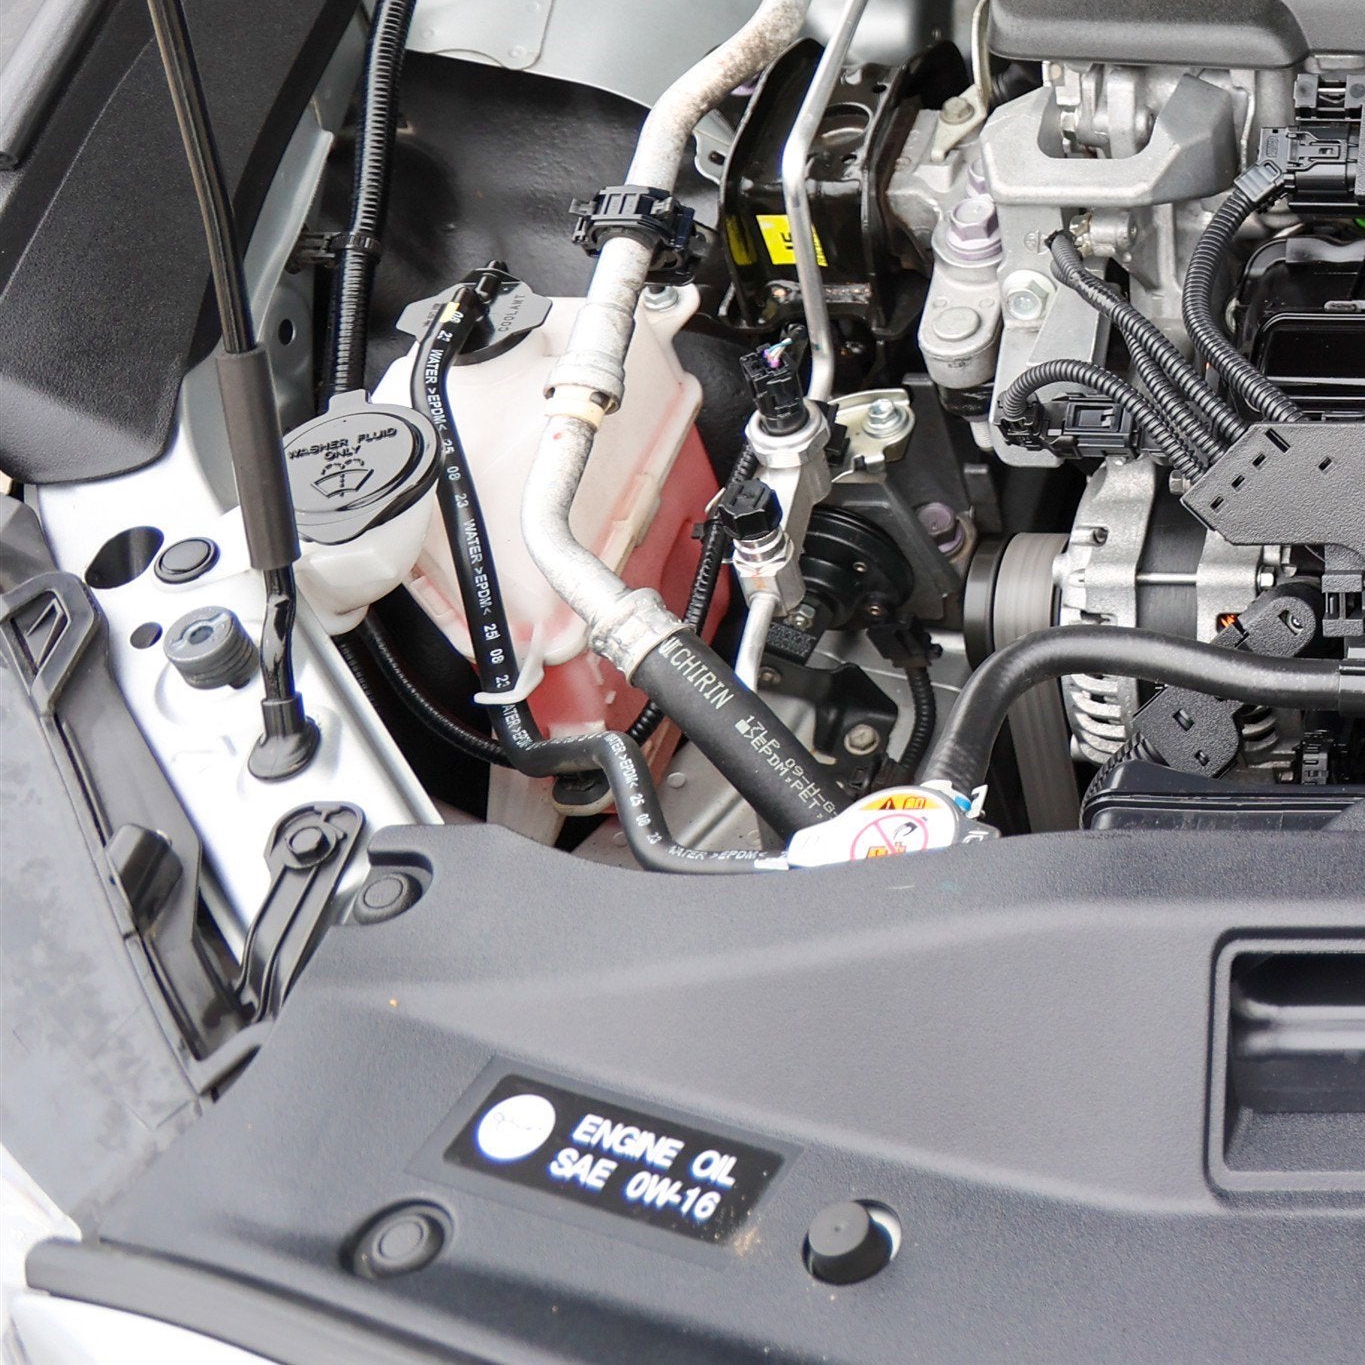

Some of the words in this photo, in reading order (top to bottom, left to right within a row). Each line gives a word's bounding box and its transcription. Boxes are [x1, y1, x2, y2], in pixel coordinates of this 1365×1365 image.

[498, 294, 526, 332] COOLANT
[425, 348, 444, 384] WATER
[289, 438, 349, 460] WASHER
[358, 427, 398, 444] FLUID
[324, 445, 361, 460] ONLY
[441, 439, 455, 454] 25
[446, 465, 461, 481] 08
[454, 493, 469, 509] 23
[463, 518, 483, 564] WATER
[474, 566, 493, 615] >EPDM<
[490, 648, 505, 664] 08
[502, 704, 522, 729] ATER
[629, 792, 646, 808] 25
[572, 1113, 685, 1169] ENGINE
[690, 1148, 738, 1188] OIL
[547, 1146, 617, 1190] SAE
[626, 1171, 722, 1223] 0W-16
